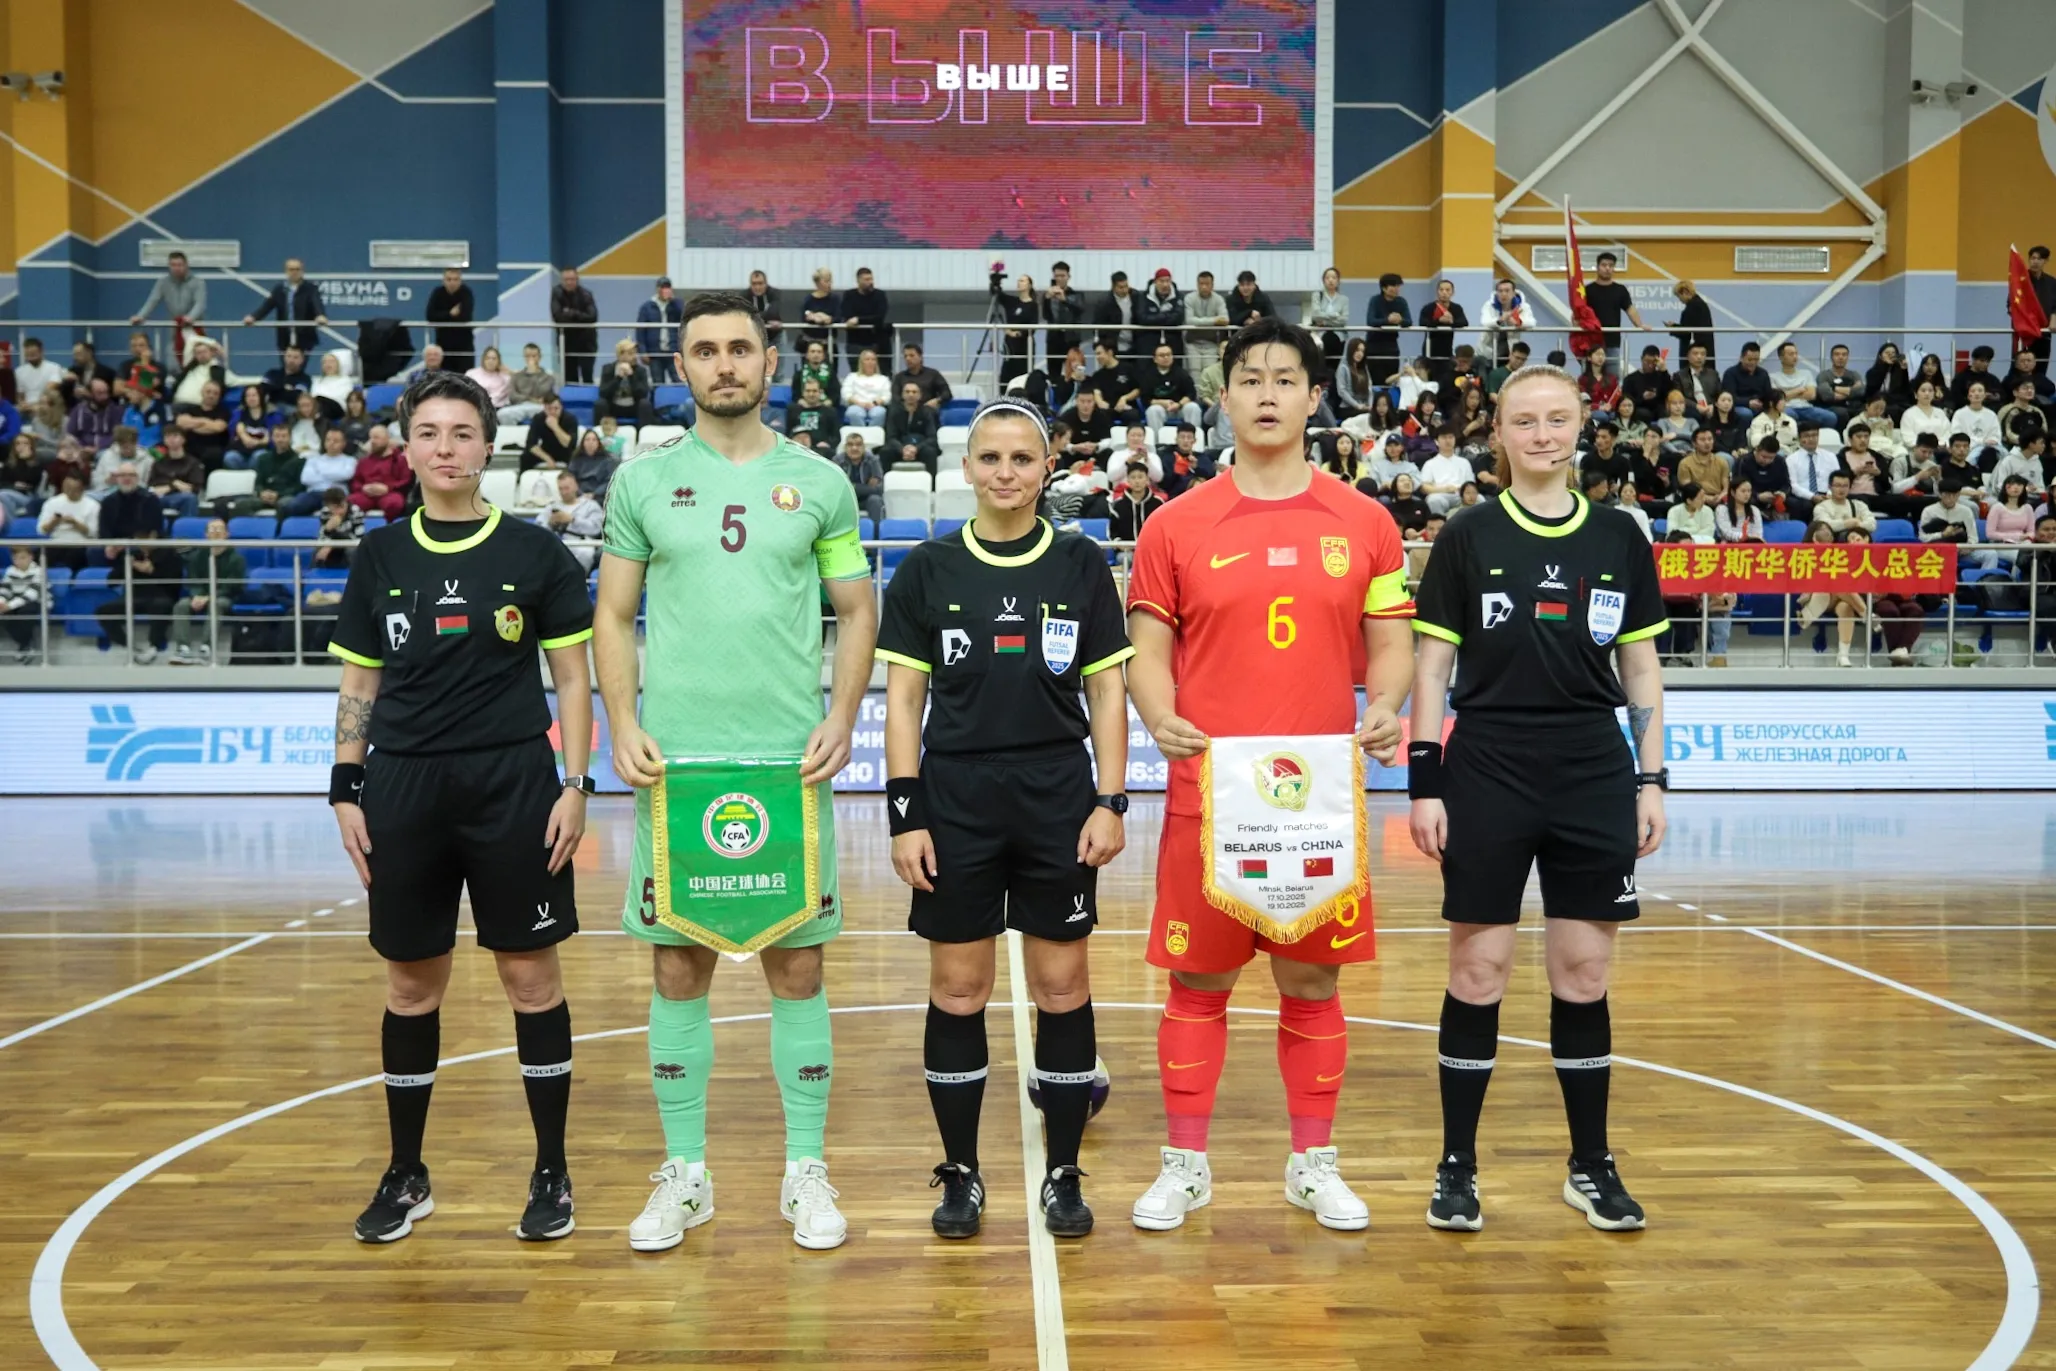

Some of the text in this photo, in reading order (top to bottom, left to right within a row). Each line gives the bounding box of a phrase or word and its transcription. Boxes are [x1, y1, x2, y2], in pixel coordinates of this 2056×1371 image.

[745, 27, 1264, 125] ВЫШЕ
[935, 63, 1070, 91] ВЫШЕ
[318, 281, 389, 294] ИБУНА
[720, 505, 747, 553] 5
[1323, 539, 1346, 548] CFA
[1658, 547, 1945, 580] 俄罗斯华侨华人总会
[1594, 593, 1621, 609] FIFA
[994, 613, 1025, 622] JÖGEL
[1268, 596, 1296, 650] 6
[1046, 621, 1074, 638] FIFA
[1049, 641, 1069, 649] FUTSAL
[1047, 648, 1070, 656] REFEREE
[1733, 724, 1856, 740] БЕЛОРУССКАЯ
[208, 727, 273, 764] БЧ
[1664, 724, 1725, 761] БЧ
[1734, 747, 1907, 764] ЖЕЛЕЗНАЯ ДОРОГА
[1237, 822, 1328, 834] Friendly matches
[727, 832, 745, 840] CFA
[1224, 843, 1282, 853] BELARUS
[1301, 840, 1344, 851] CHINA
[689, 873, 786, 891] 中国足球协会
[748, 889, 787, 897] ASSOCIATION
[640, 877, 656, 926] 5
[1170, 923, 1189, 932] CFA
[1576, 1059, 1609, 1067] JÖGE
[524, 1067, 566, 1075] JÖGEL
[1044, 1073, 1096, 1081] JÖGEL
[384, 1074, 420, 1085] ÖGEL
